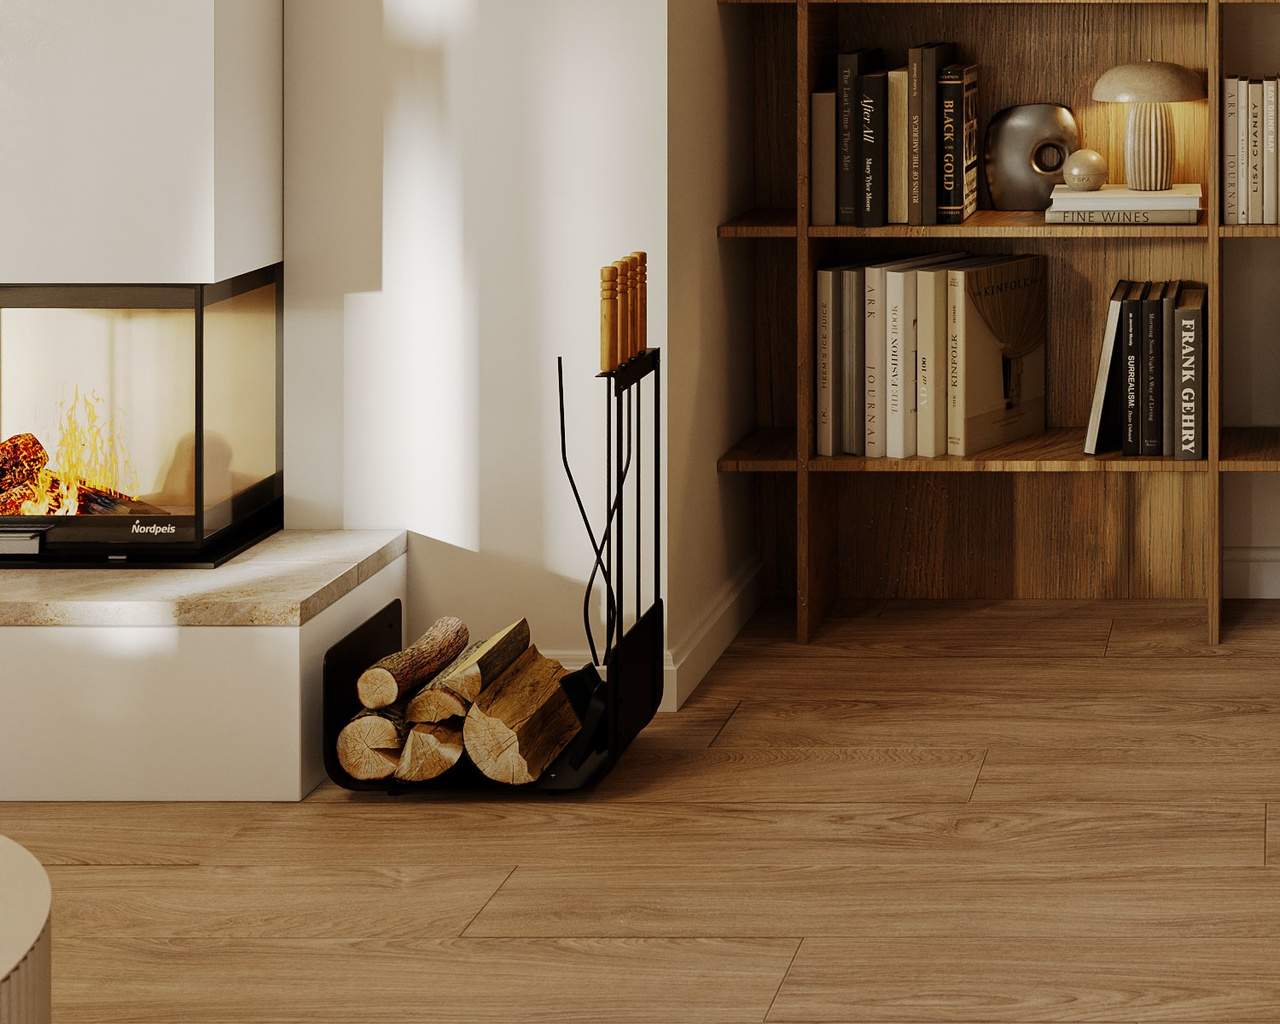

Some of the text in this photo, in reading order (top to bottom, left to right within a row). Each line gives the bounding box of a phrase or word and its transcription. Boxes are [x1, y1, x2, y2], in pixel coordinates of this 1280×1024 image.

[843, 68, 851, 171] The Last Time They Met
[860, 94, 875, 144] After All
[943, 100, 955, 191] BLACK GOLD
[1267, 85, 1275, 154] EAT DRINK NAP
[865, 157, 873, 212] Mary Tyler Moore
[913, 171, 919, 182] OF
[1227, 92, 1235, 217] ARK JOURNAL
[1063, 211, 1150, 223] FINE WINES
[984, 278, 1030, 297] KINFOLK
[867, 285, 876, 446] ARK JOURNAL
[891, 305, 899, 414] THE FASHION BOOK
[1181, 319, 1195, 454] FRANK GEHRY
[131, 519, 176, 535] Nordpeis
